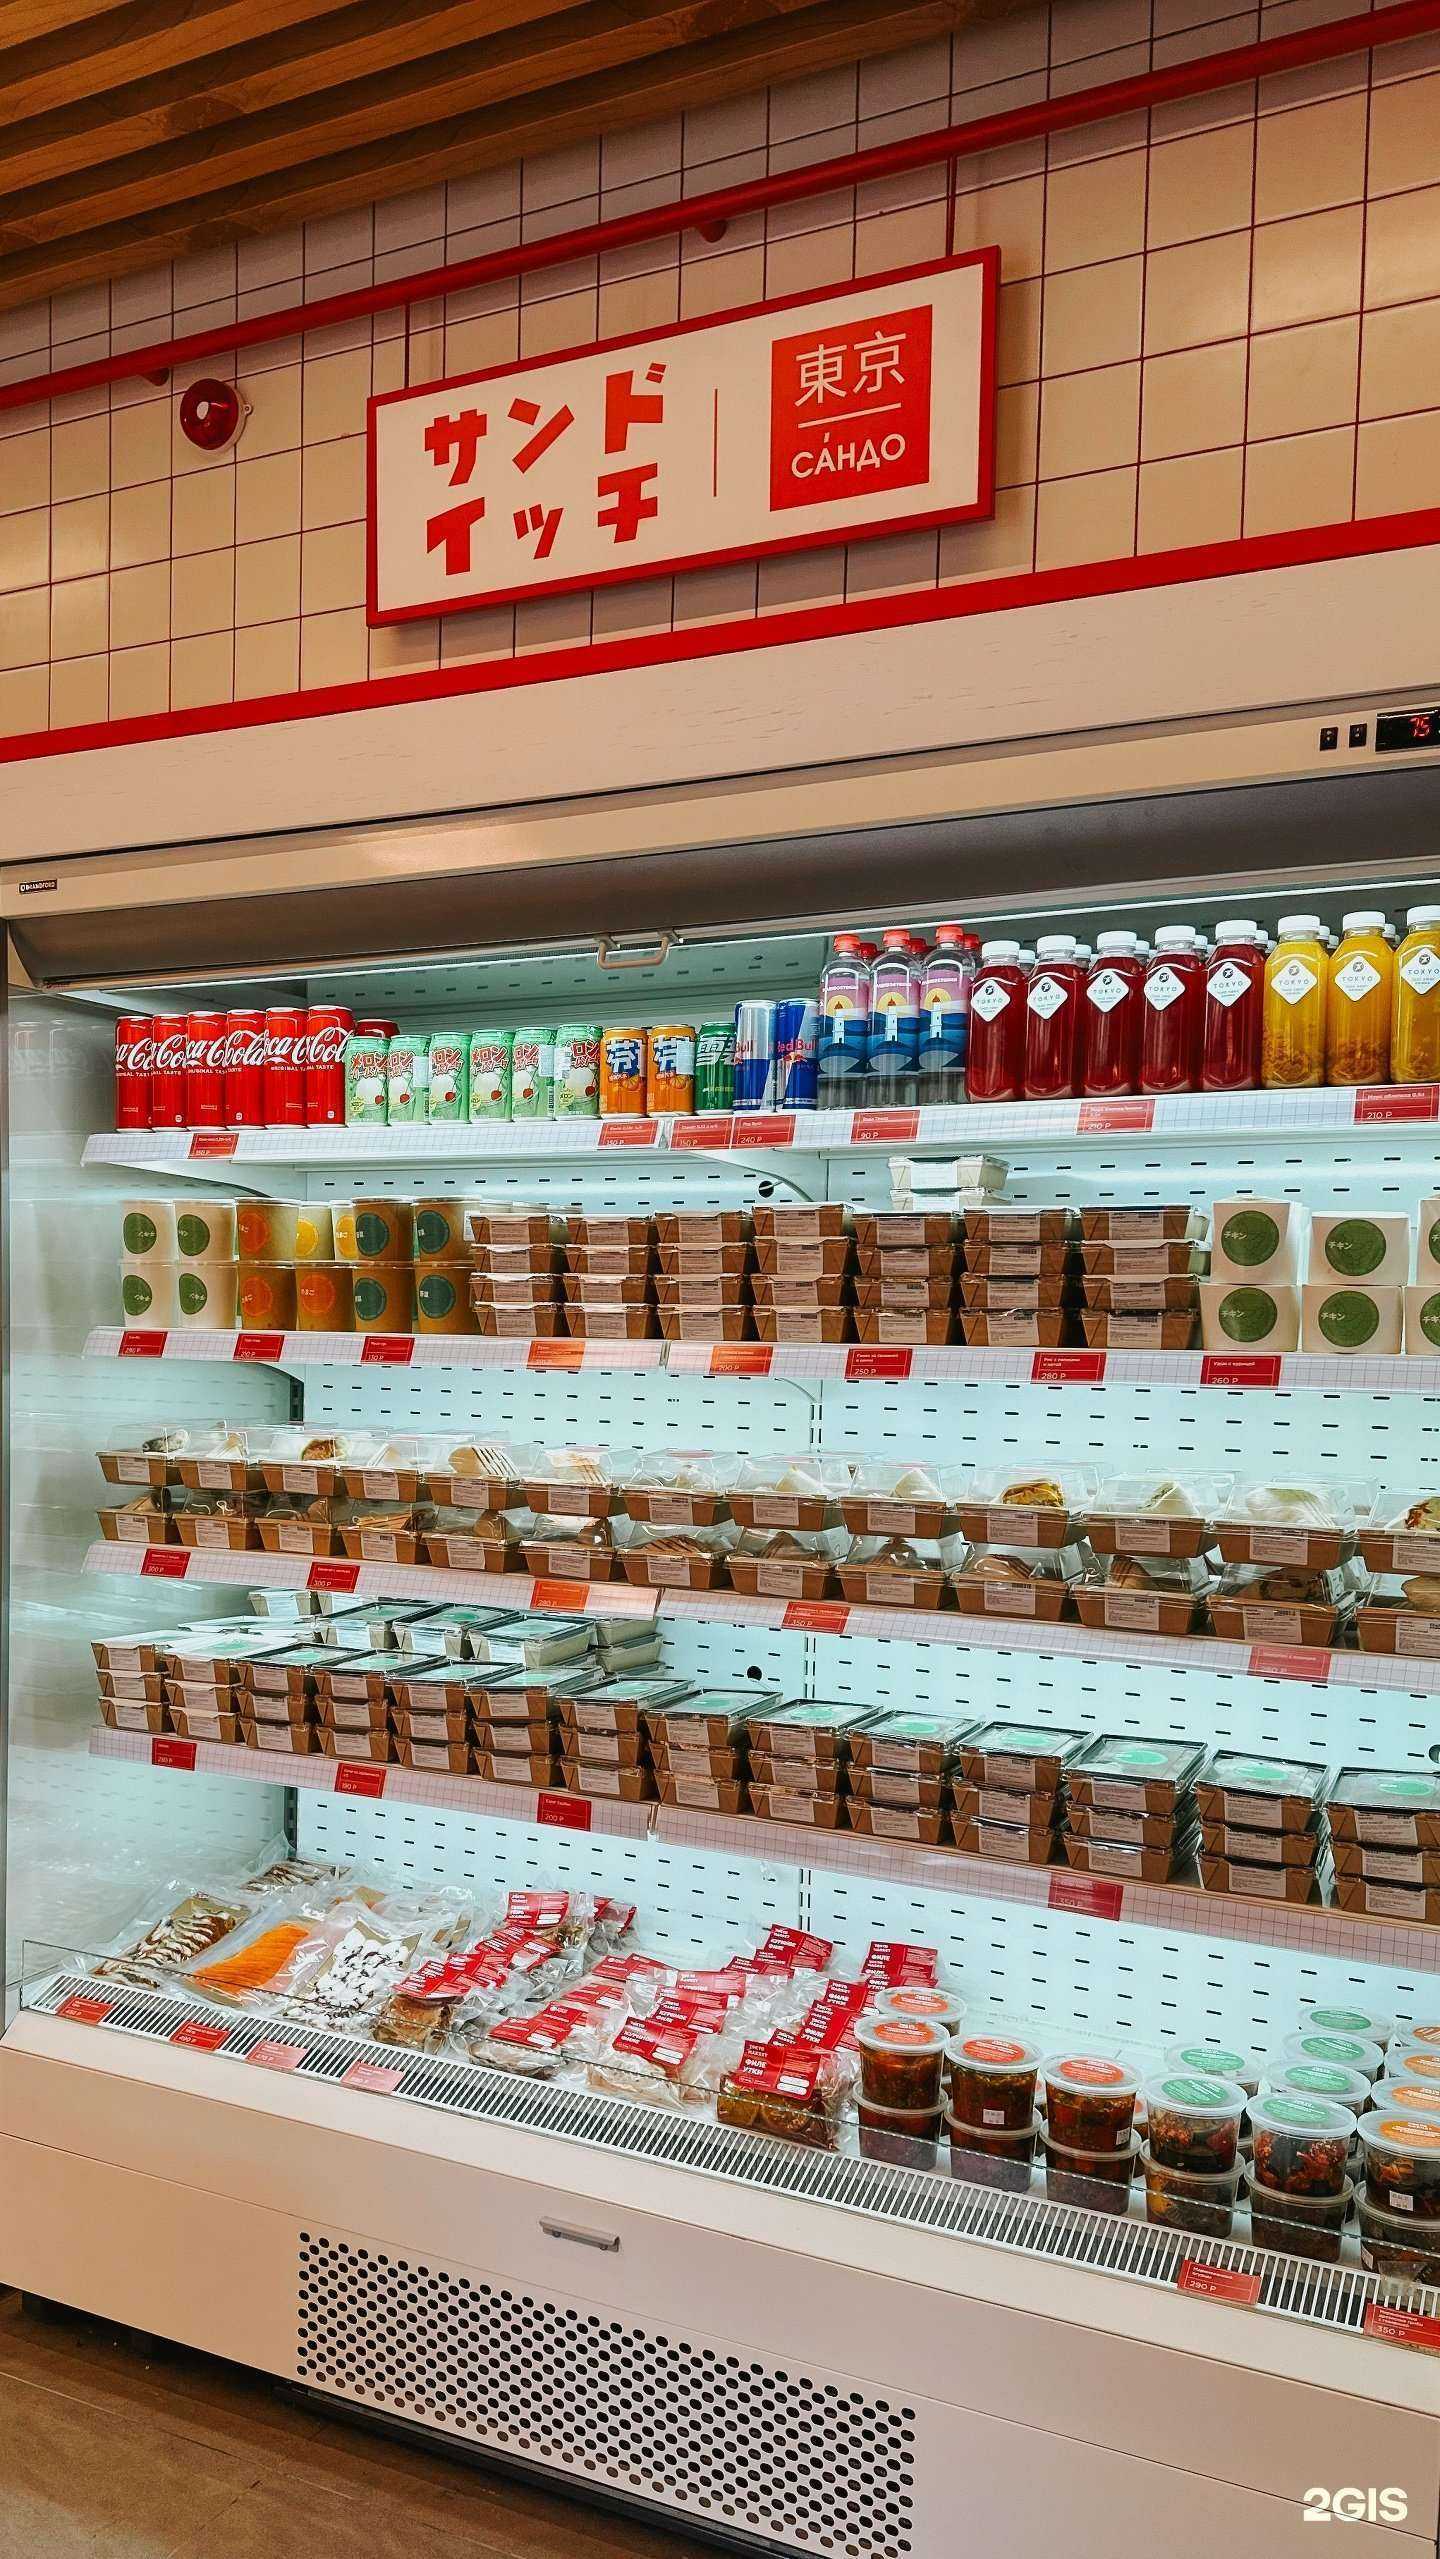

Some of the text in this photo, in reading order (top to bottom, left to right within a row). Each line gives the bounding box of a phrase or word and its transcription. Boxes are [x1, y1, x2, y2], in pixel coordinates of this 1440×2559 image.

[794, 330, 906, 407] 東京
[424, 362, 667, 487] サンド
[426, 462, 658, 576] イッチ
[796, 1039, 816, 1052] Bull
[1367, 1111, 1383, 1120] 210
[1223, 1231, 1247, 1240] チキン
[1328, 1241, 1353, 1250] チキン
[1221, 1310, 1245, 1319] チキン
[1321, 1312, 1346, 1320] チキン
[745, 2058, 767, 2068] ФИЛЕ
[743, 2066, 764, 2076] УТКИ
[1190, 2280, 1208, 2290] 290
[1376, 2325, 1396, 2335] 350
